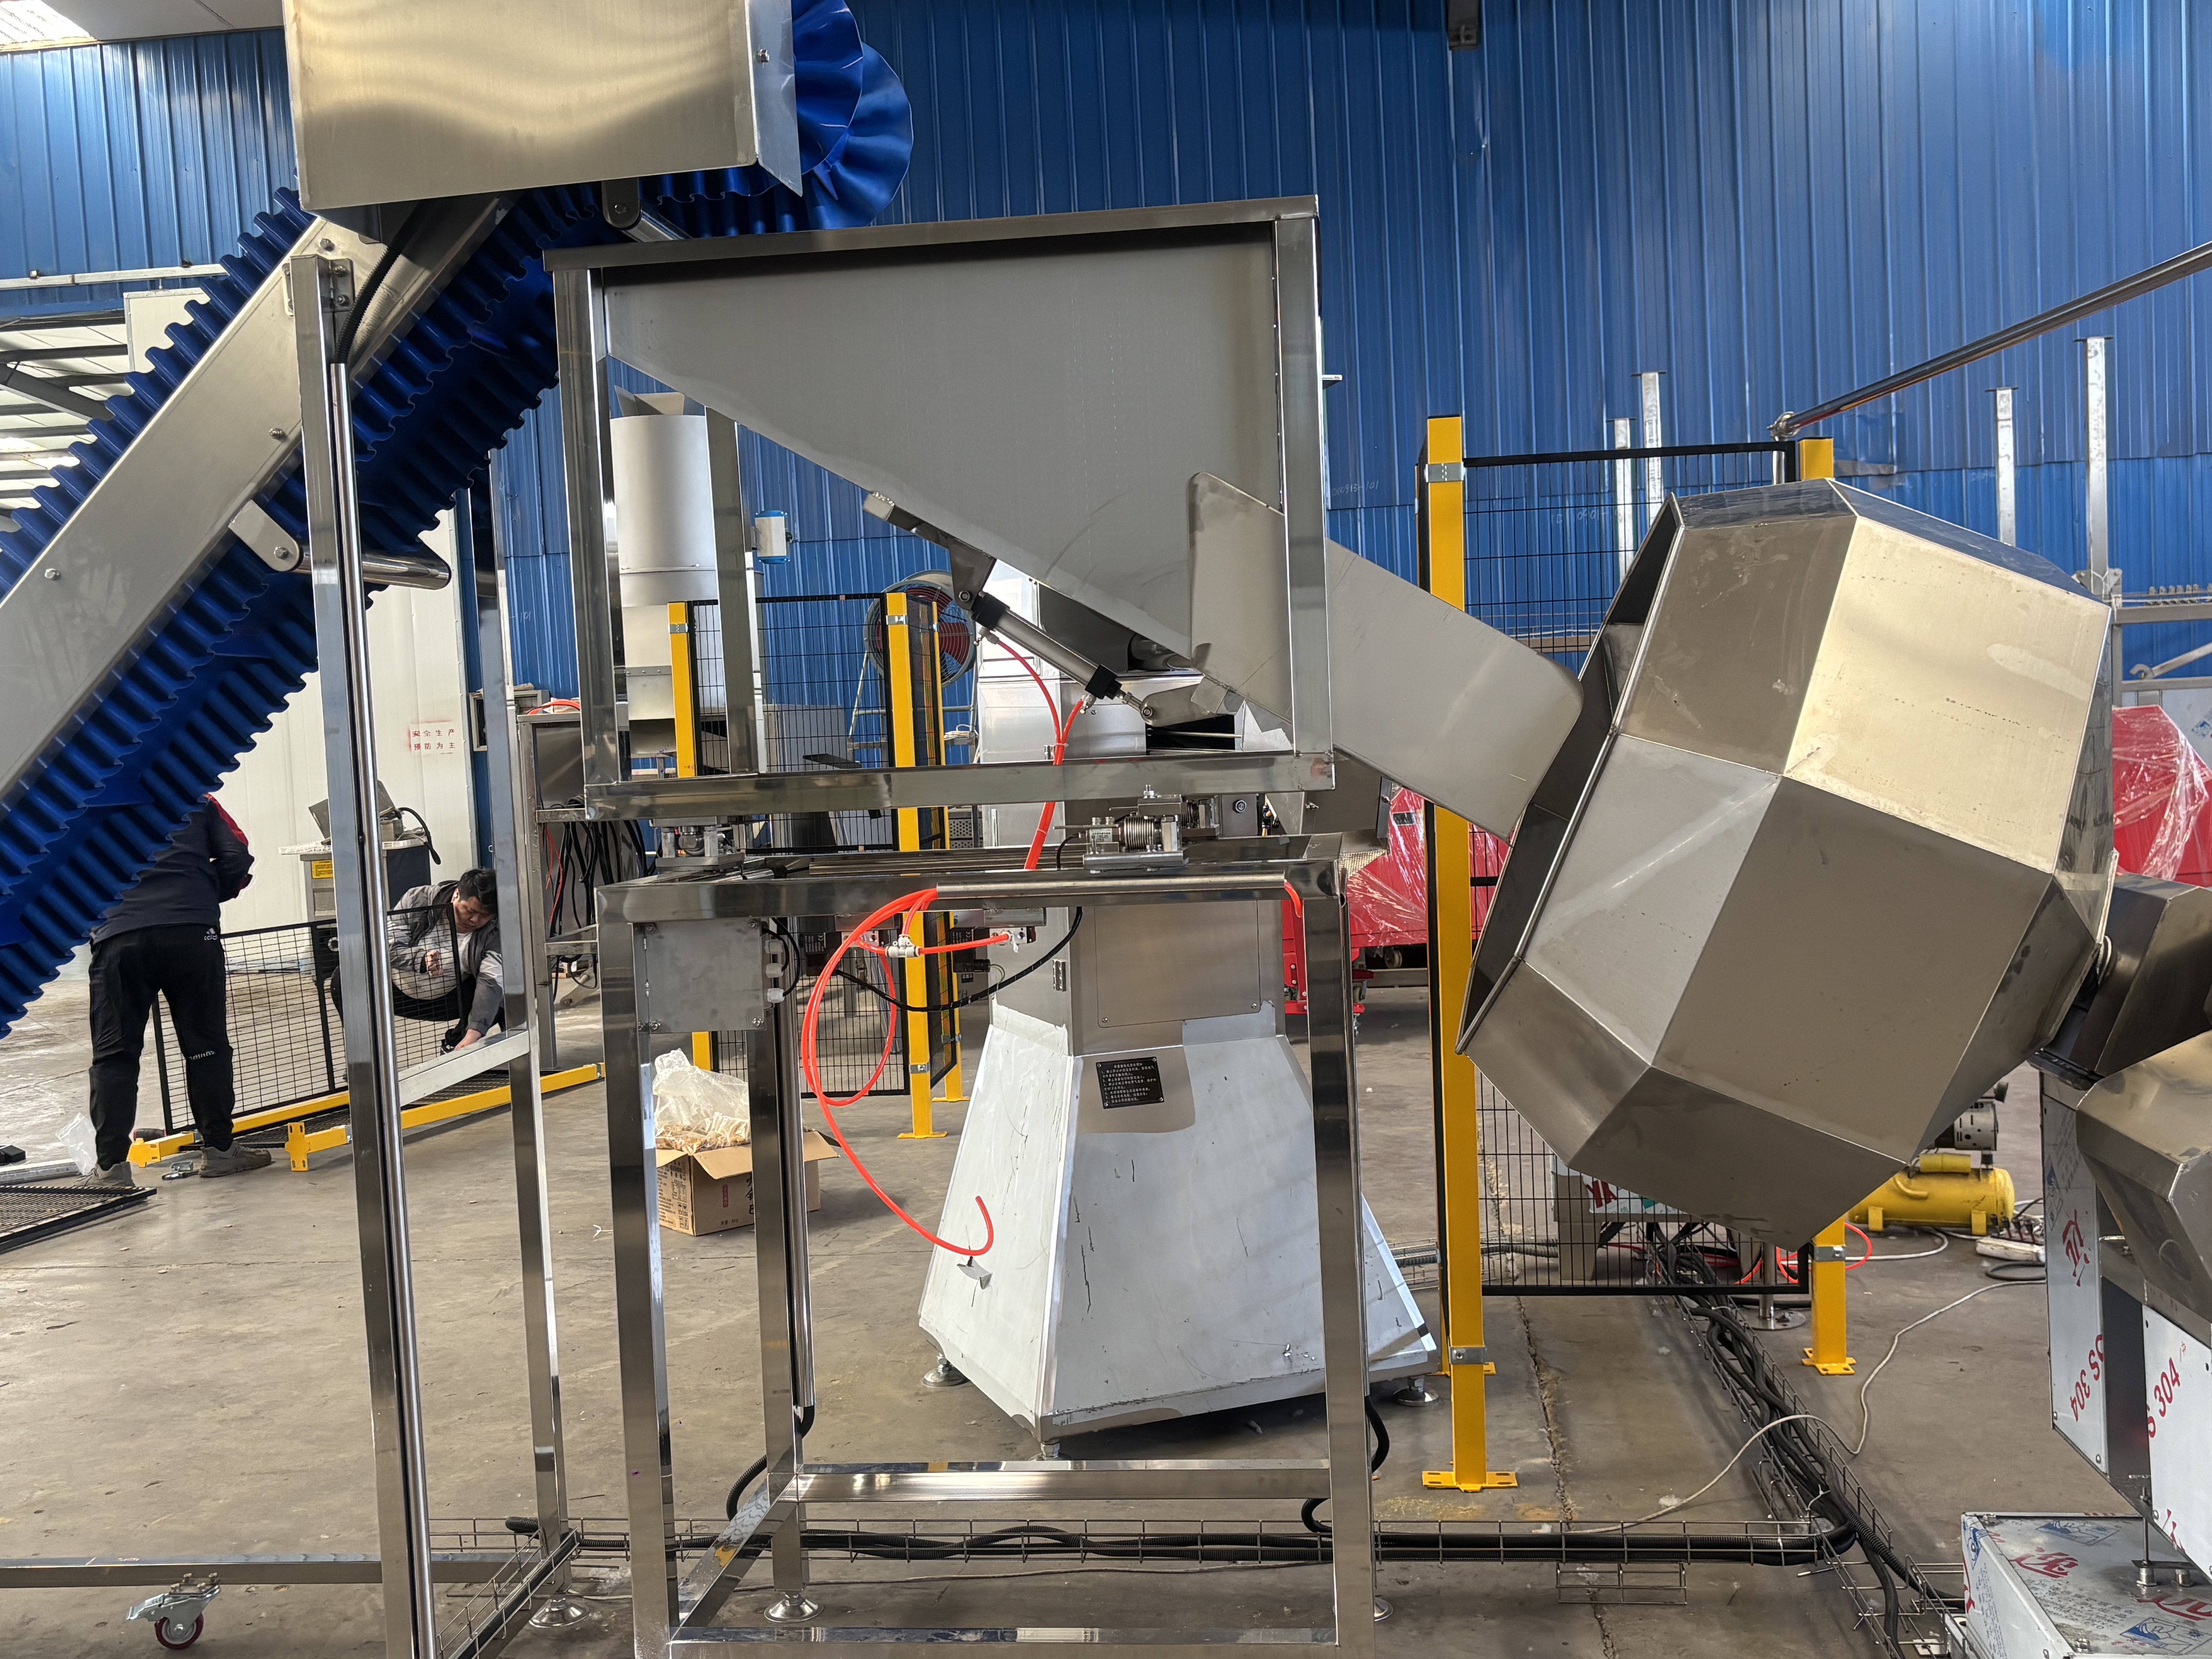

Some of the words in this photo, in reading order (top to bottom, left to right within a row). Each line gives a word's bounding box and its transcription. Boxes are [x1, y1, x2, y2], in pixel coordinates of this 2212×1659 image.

[412, 729, 455, 737] 安全生产
[414, 742, 456, 750] 预防为主
[2070, 1369, 2090, 1422] 304
[2154, 1357, 2180, 1417] 304
